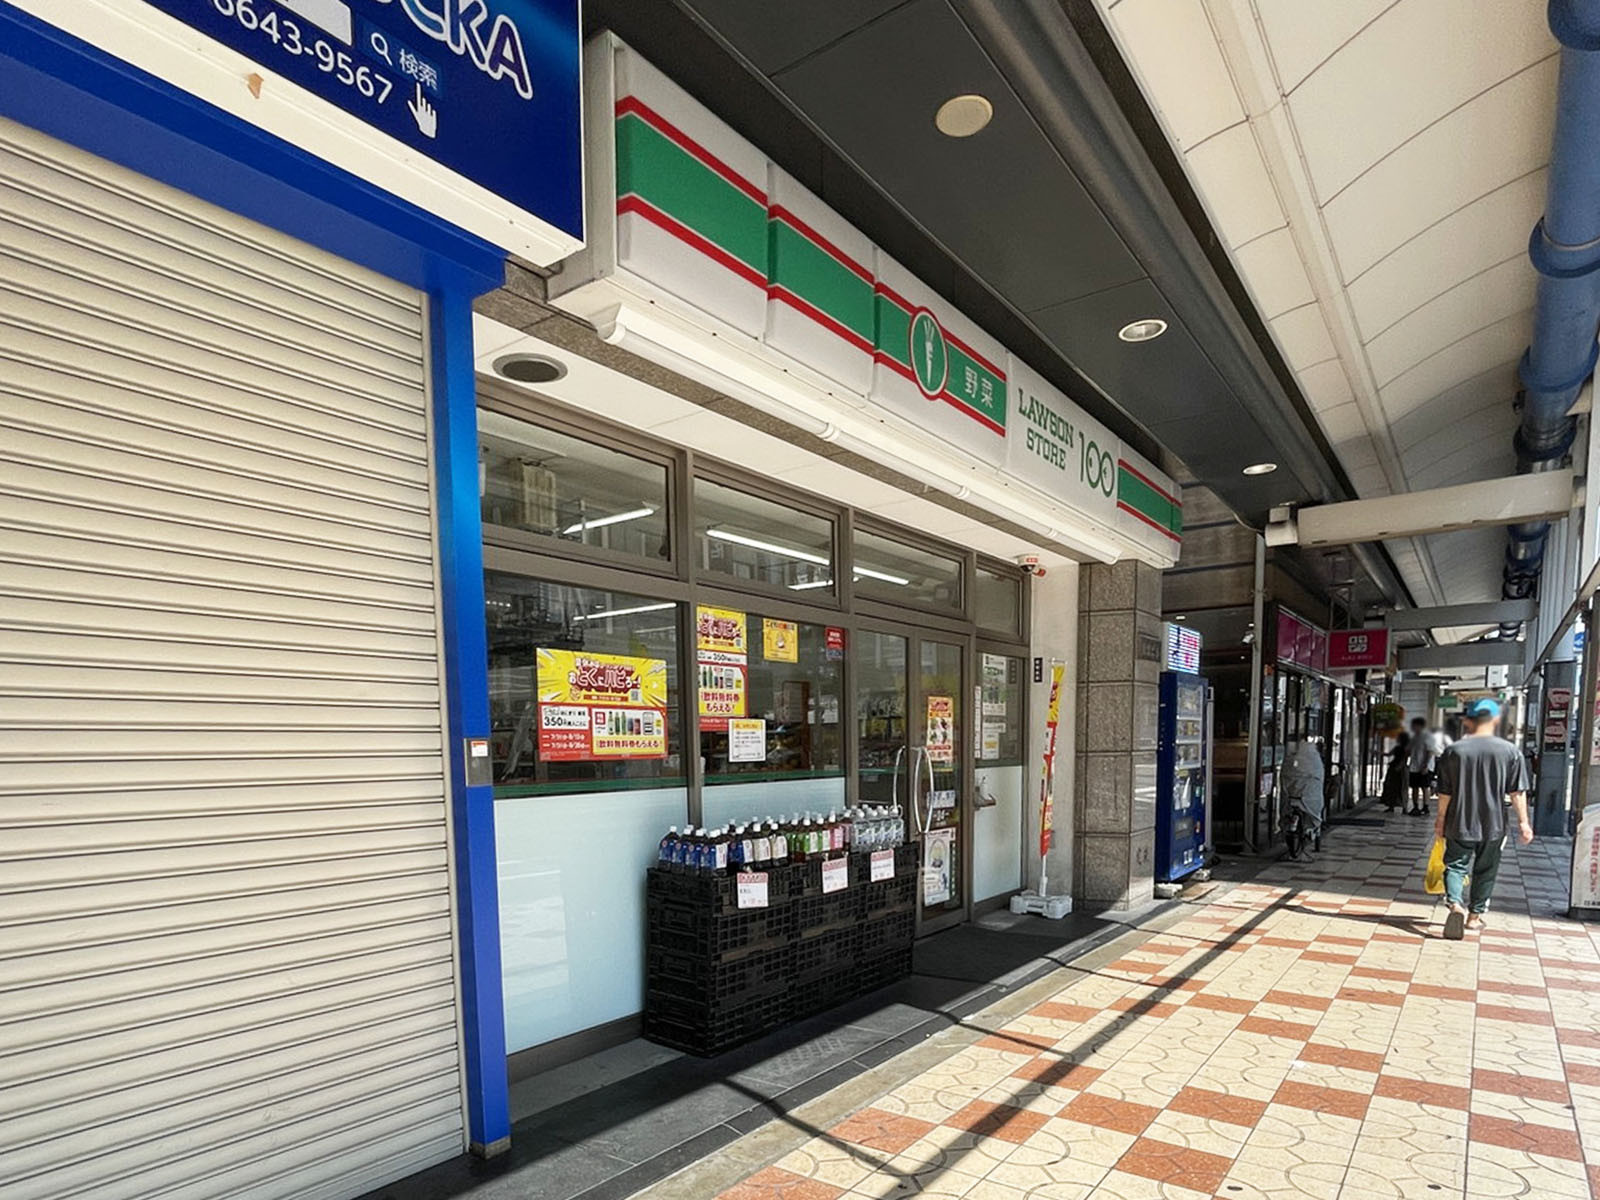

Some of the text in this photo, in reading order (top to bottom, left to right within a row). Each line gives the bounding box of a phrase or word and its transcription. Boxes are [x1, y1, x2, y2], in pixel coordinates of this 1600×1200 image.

[399, 48, 438, 91] 検索
[965, 365, 993, 409] 野菜
[1018, 388, 1075, 448] LAWSON
[1026, 427, 1067, 471] STORE
[1078, 430, 1115, 498] 100
